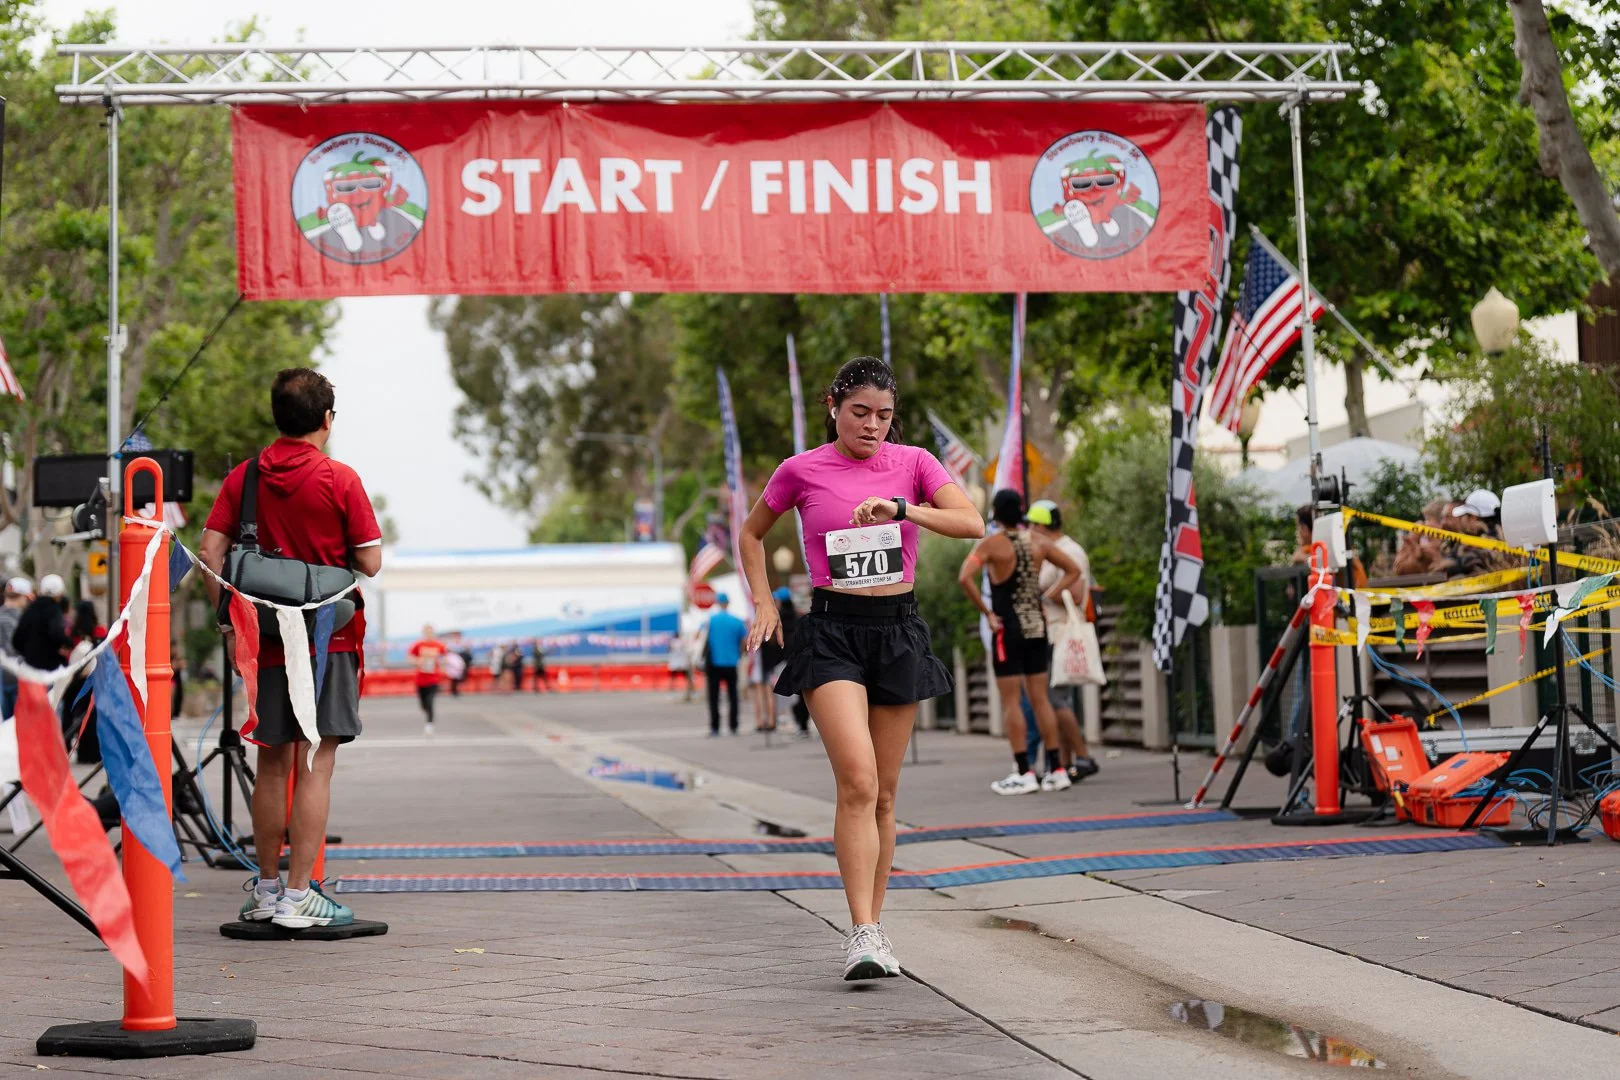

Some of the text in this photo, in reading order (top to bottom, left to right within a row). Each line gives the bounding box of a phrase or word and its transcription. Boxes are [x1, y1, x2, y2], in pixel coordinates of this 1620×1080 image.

[461, 157, 992, 216] START / FINISH
[845, 550, 888, 577] 570
[845, 578, 872, 587] STRAWBERRY
